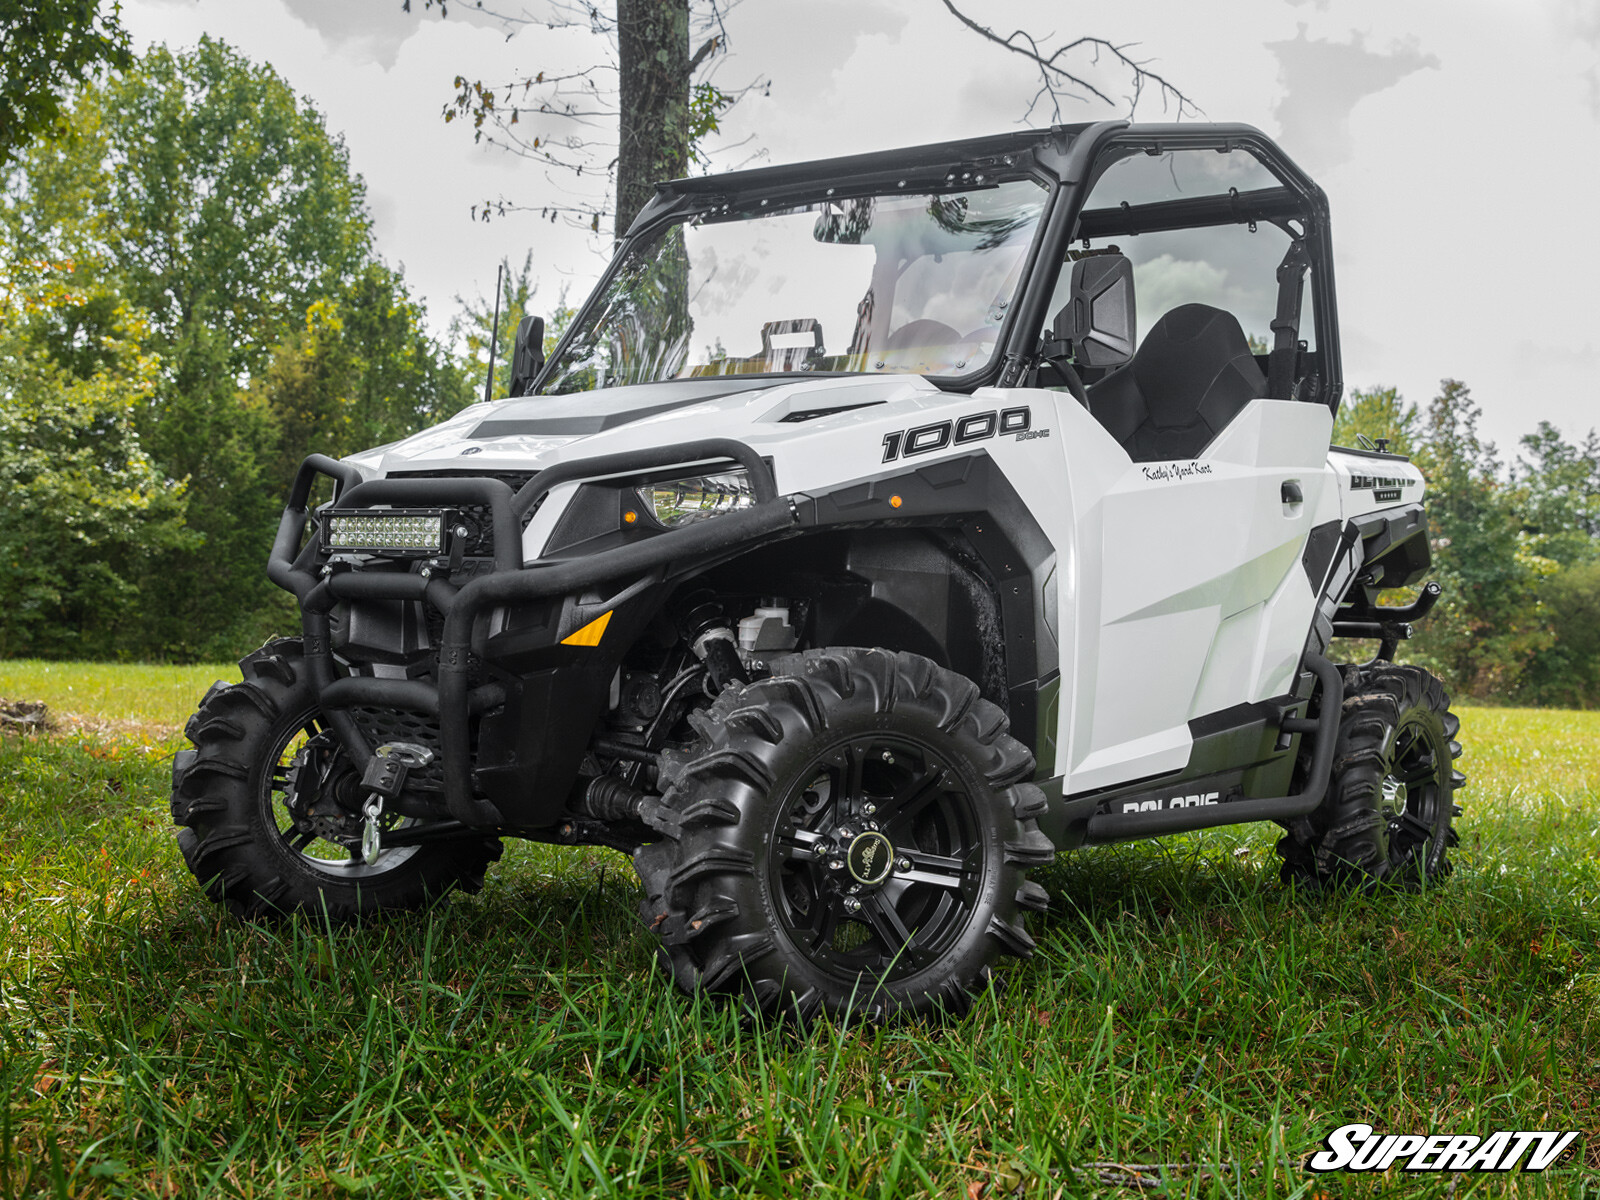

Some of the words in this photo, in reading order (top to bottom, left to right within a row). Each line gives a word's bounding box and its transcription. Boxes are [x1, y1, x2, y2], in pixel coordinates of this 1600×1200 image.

[881, 405, 1032, 464] 1000
[1015, 428, 1051, 442] DOHC
[1142, 465, 1174, 482] Kathy's
[1172, 463, 1194, 480] Yard
[1191, 461, 1212, 475] Kart
